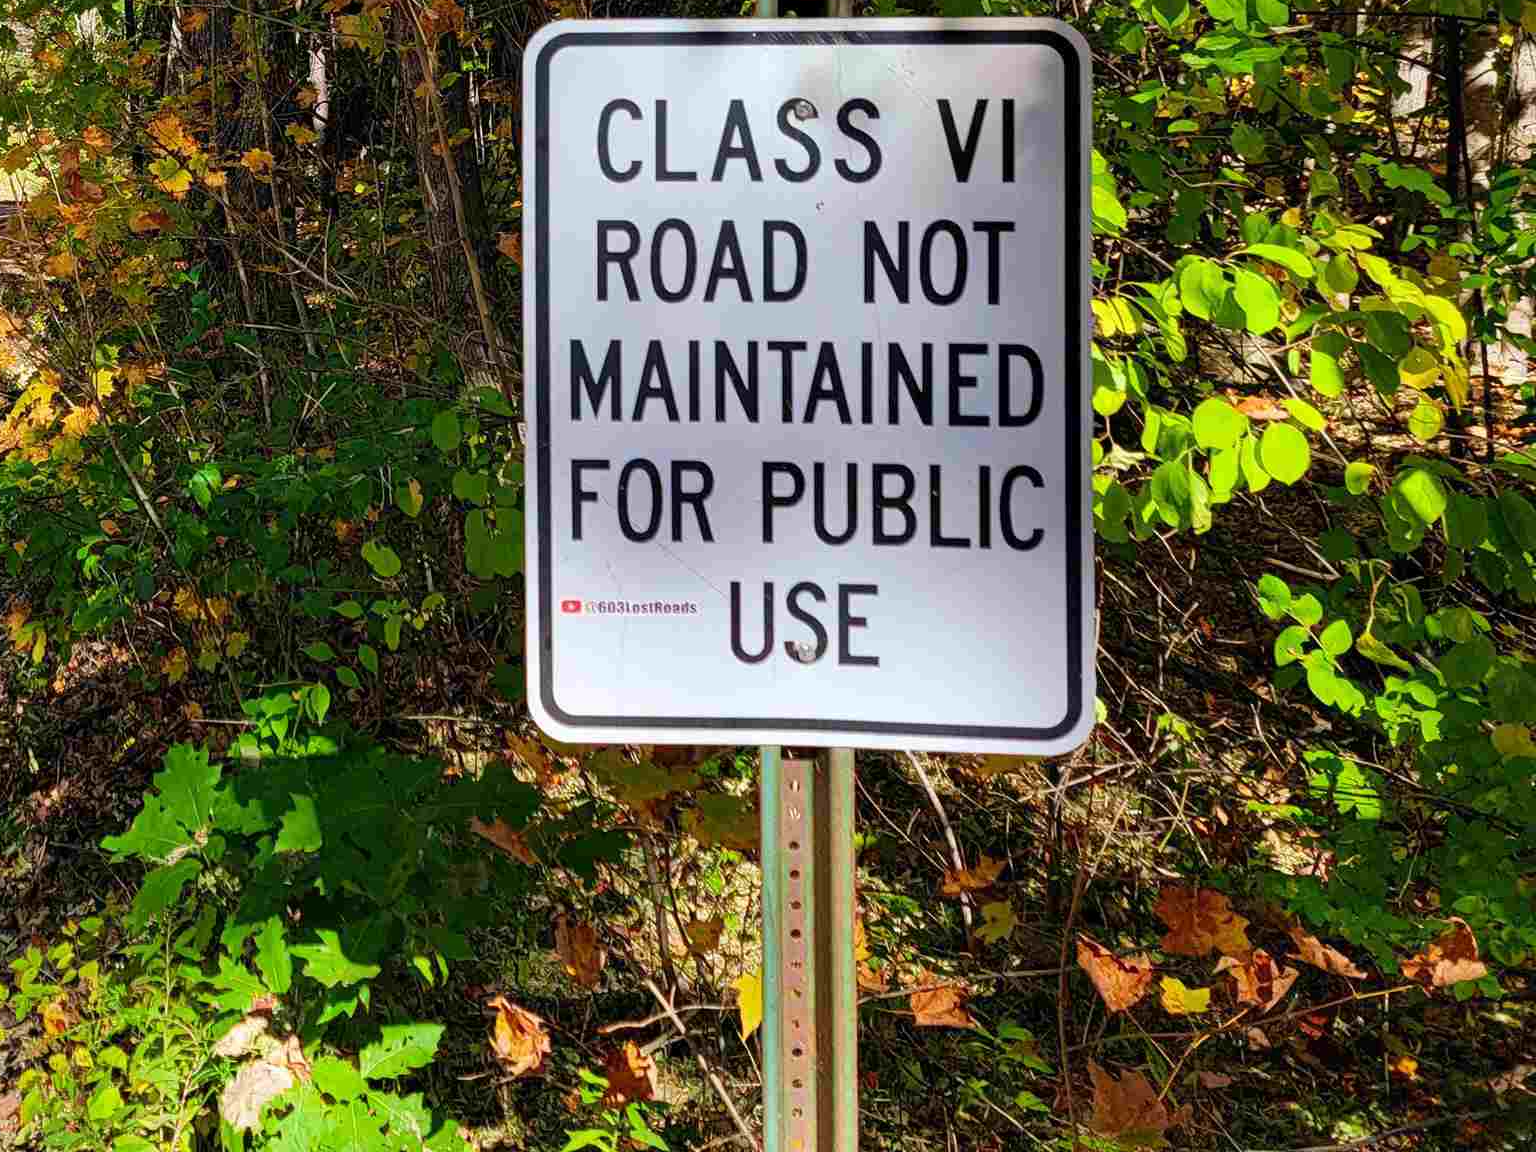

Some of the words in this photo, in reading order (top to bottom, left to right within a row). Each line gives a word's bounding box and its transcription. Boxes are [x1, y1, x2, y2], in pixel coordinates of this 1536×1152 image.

[596, 97, 884, 184] CLASS
[936, 98, 1017, 184] VI
[596, 218, 809, 304] ROAD
[863, 218, 1017, 307] NOT
[569, 339, 1046, 429] MAINTAINED
[570, 457, 716, 544] FOR
[761, 459, 1047, 552] PUBLIC
[729, 580, 881, 667] USE
